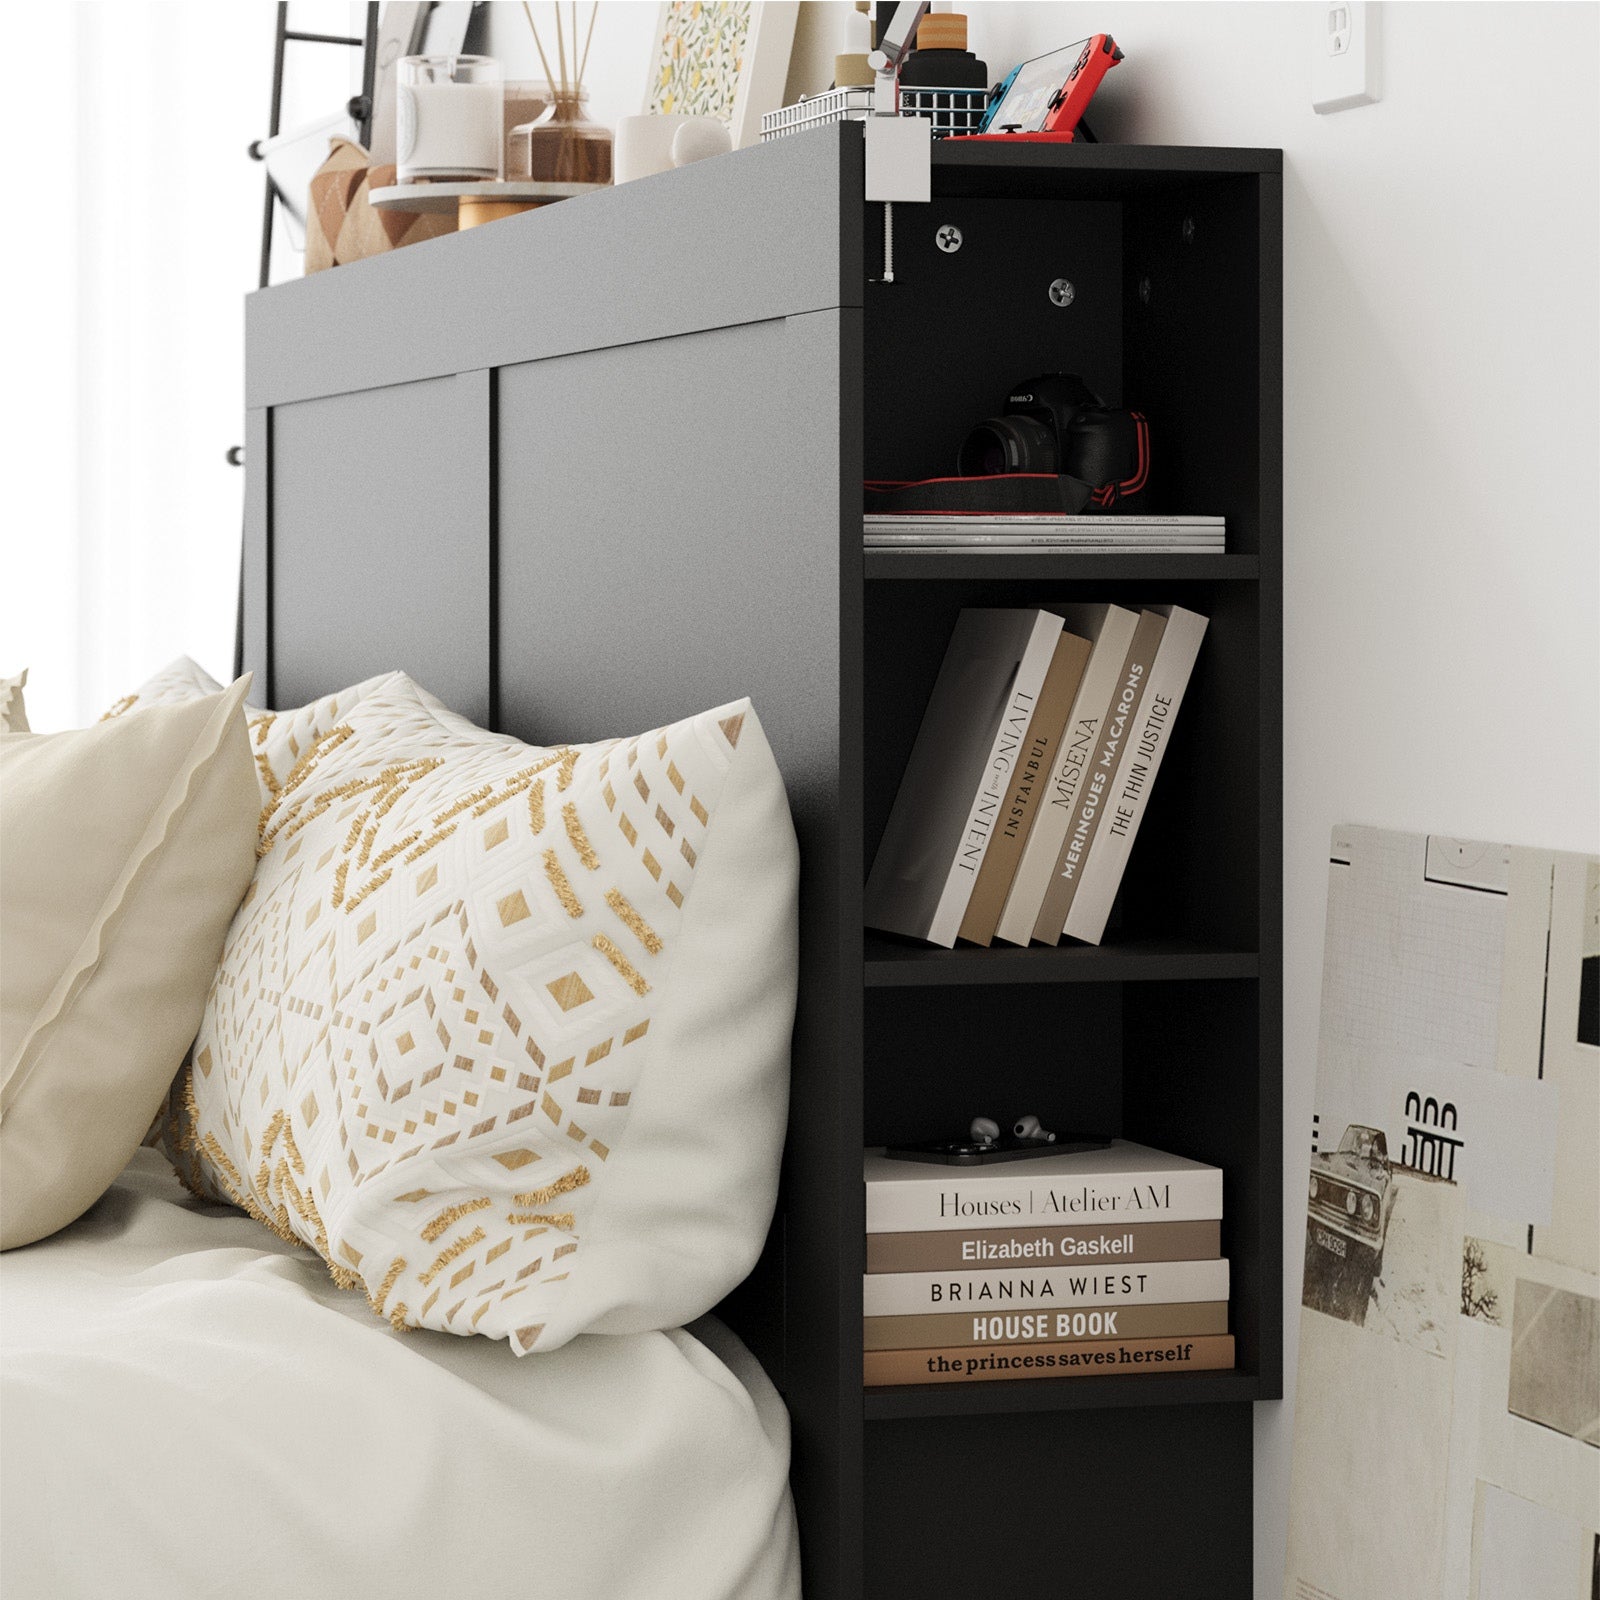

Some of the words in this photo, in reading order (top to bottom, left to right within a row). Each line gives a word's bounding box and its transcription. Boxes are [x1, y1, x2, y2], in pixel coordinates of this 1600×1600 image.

[993, 692, 1033, 773] LIVING
[1052, 717, 1098, 810] MÍSENA
[1061, 772, 1107, 879] MERINGUES
[1100, 663, 1143, 767] MACARONS
[1110, 808, 1134, 837] THE
[1122, 763, 1148, 801] THIN
[1138, 694, 1172, 761] JUSTICE
[1004, 736, 1048, 838] INSTANBUL
[959, 791, 1000, 875] INTENT
[939, 1192, 1022, 1217] Houses
[1041, 1187, 1121, 1214] Atelier
[1125, 1184, 1171, 1210] AM
[962, 1237, 1054, 1260] Elizabeth
[1060, 1234, 1134, 1256] Gaskell
[931, 1279, 1055, 1302] BRIANNA
[1069, 1275, 1148, 1296] WIEST
[973, 1315, 1048, 1341] HOUSE
[1056, 1311, 1118, 1337] BOOK
[927, 1356, 963, 1373] the
[966, 1353, 1055, 1375] princess
[1058, 1349, 1116, 1366] saves
[1118, 1344, 1193, 1364] herself
